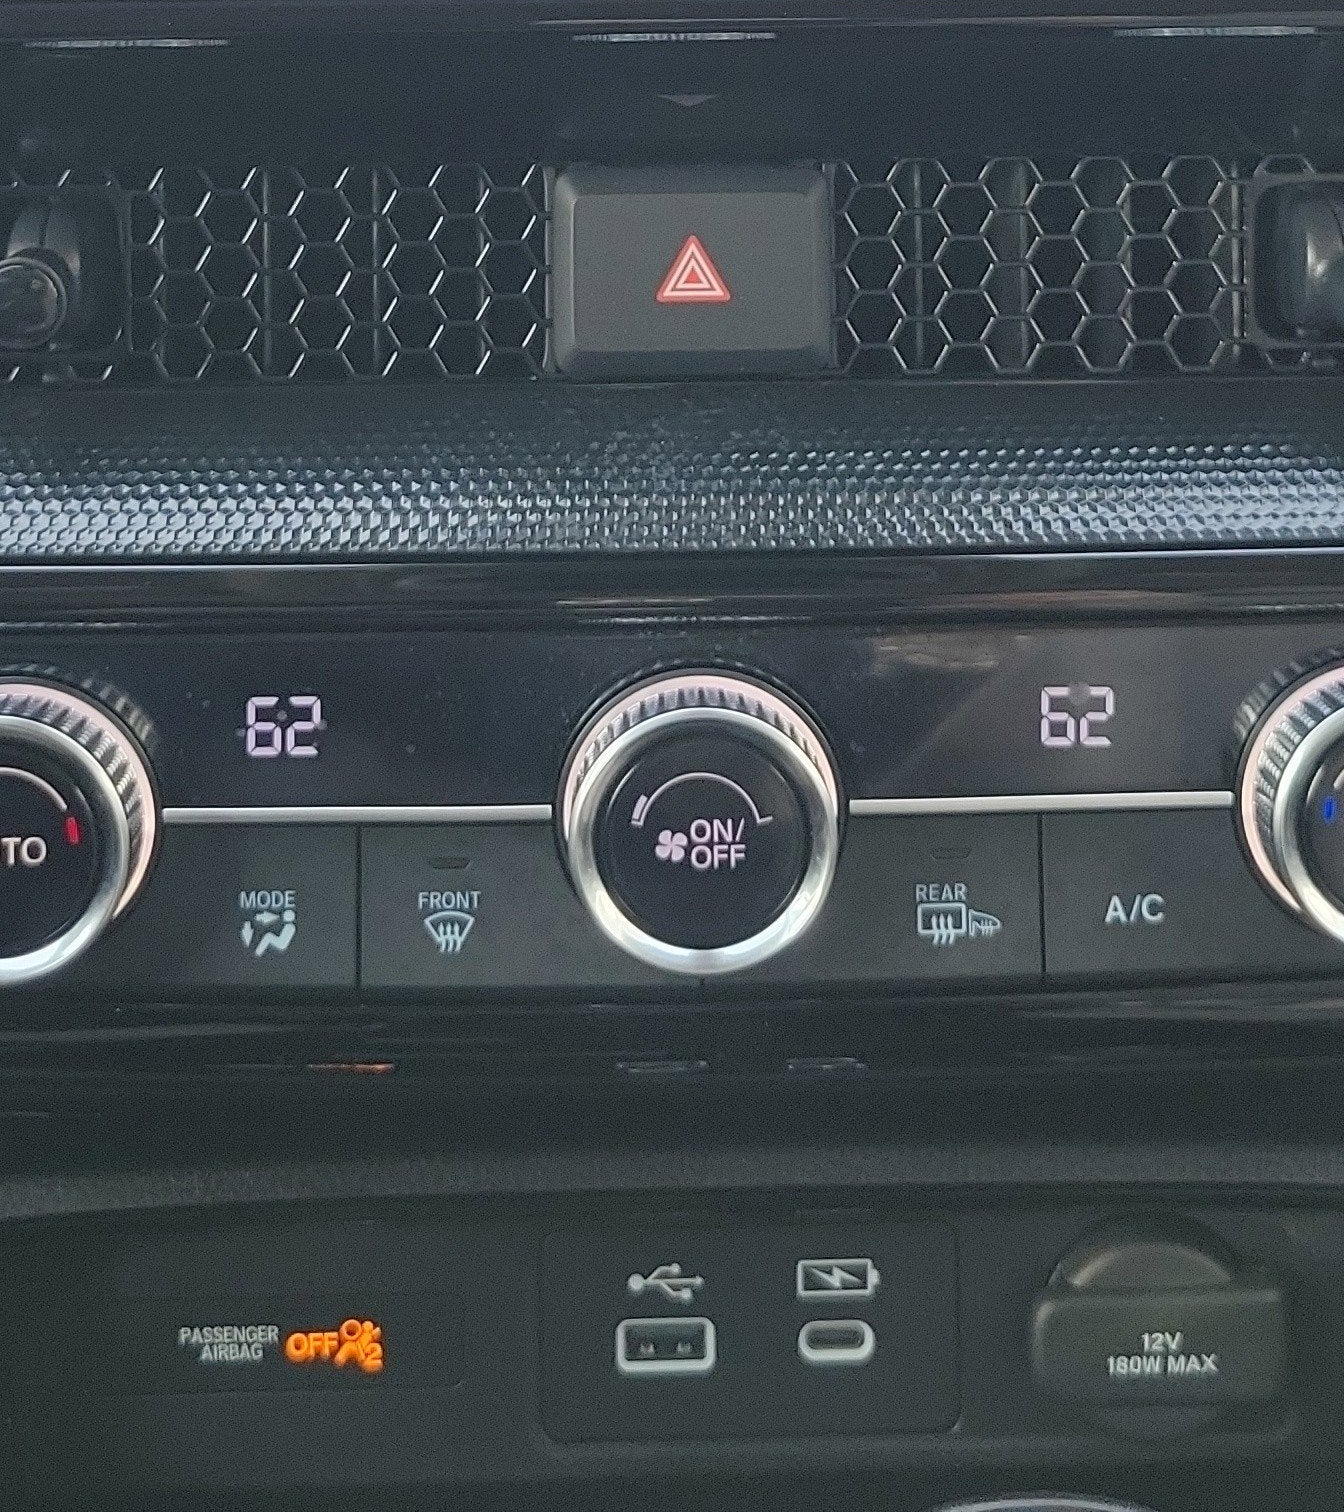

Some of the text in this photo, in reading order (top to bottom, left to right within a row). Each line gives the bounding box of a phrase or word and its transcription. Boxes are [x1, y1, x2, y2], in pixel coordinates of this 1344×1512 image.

[246, 695, 322, 757] 62
[1040, 686, 1114, 747] 62
[690, 819, 744, 844] ON/
[690, 845, 746, 869] OFF
[240, 891, 296, 909] MODE
[418, 890, 480, 910] FRONT
[916, 883, 967, 901] REAR
[1105, 894, 1165, 923] A/C
[179, 1325, 278, 1345] PASSENGER
[1141, 1331, 1183, 1352] 12V
[199, 1343, 264, 1362] AIRBAG
[286, 1332, 339, 1362] OFF
[1107, 1354, 1219, 1375] 180W MAX
